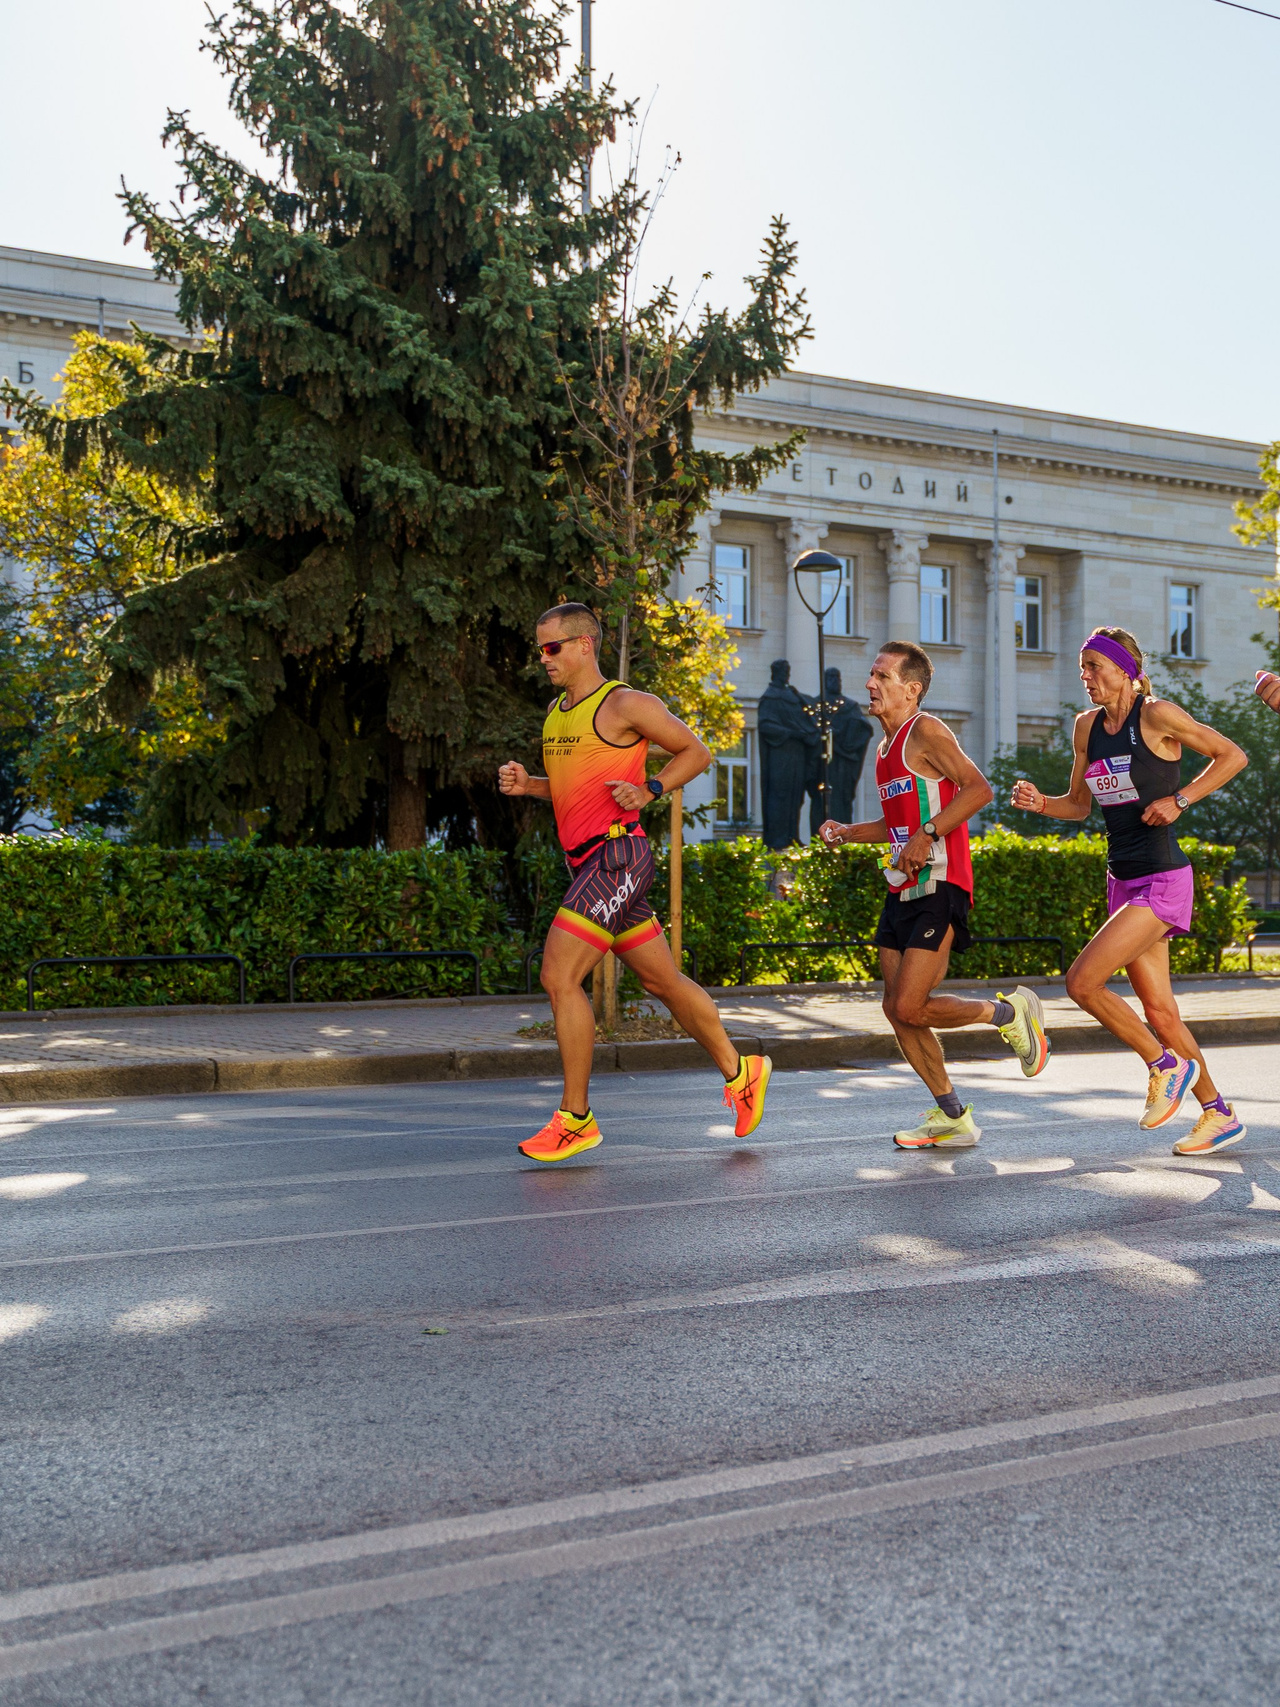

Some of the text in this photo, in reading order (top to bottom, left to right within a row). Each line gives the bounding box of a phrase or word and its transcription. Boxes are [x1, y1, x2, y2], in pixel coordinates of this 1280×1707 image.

[792, 463, 968, 503] ЕТОДИЙ
[557, 736, 583, 744] ZOOT
[1096, 775, 1119, 791] 690
[590, 899, 605, 915] TEAM
[1164, 1073, 1178, 1099] HOKA
